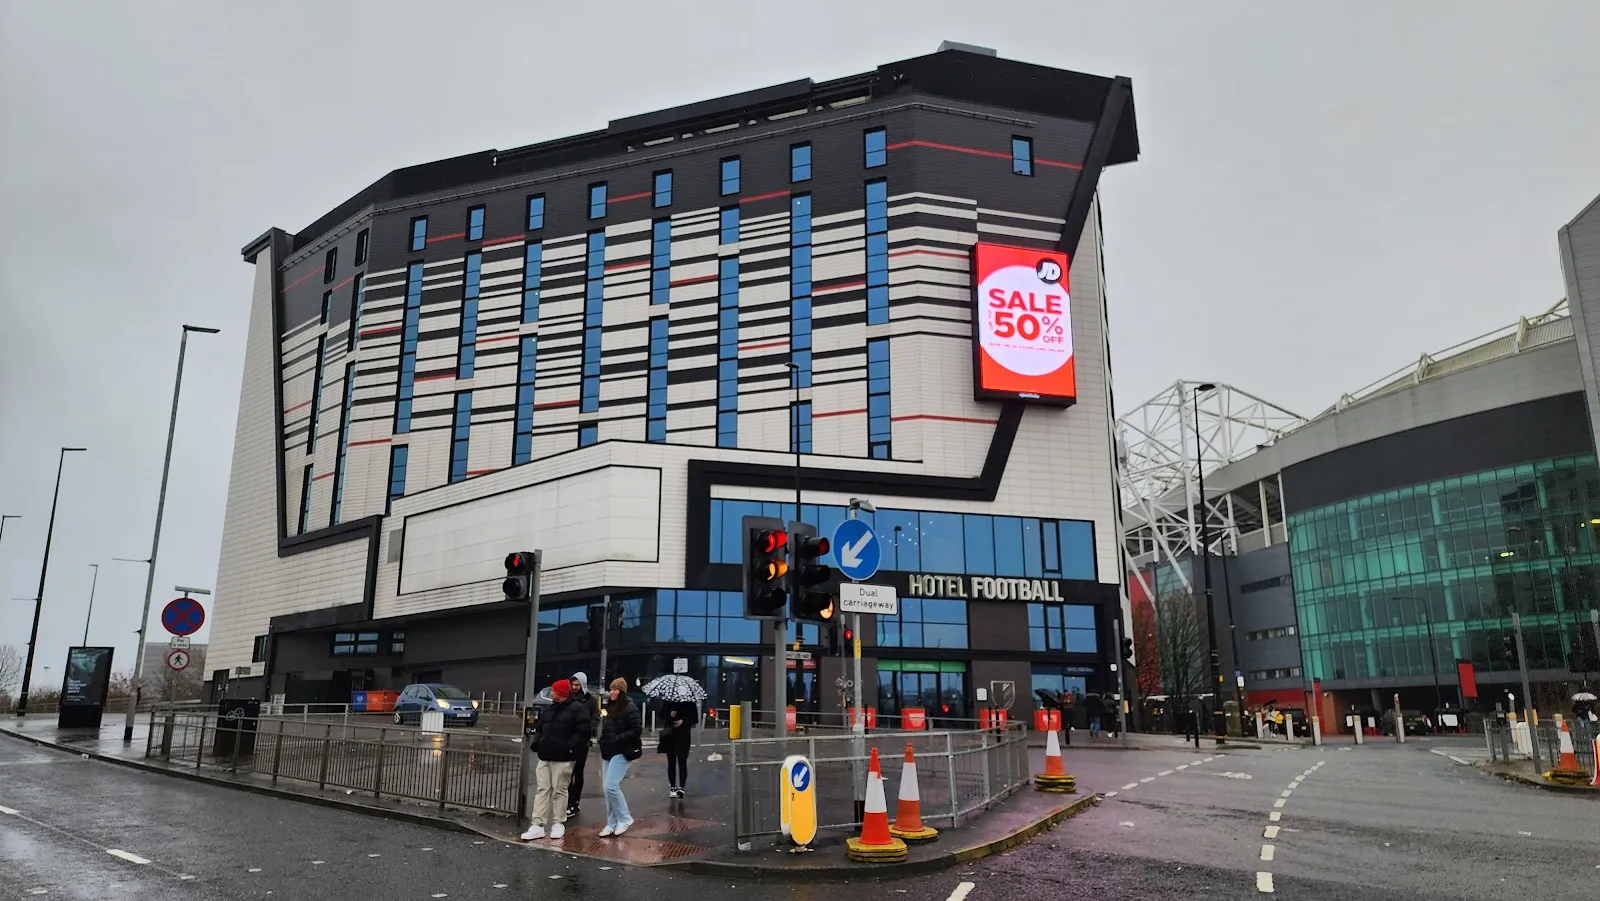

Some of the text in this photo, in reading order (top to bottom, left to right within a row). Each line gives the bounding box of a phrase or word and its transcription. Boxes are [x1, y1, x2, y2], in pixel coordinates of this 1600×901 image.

[1037, 261, 1061, 280] JD
[989, 288, 1062, 315] SALE
[1042, 335, 1064, 344] OFF
[859, 588, 878, 597] Dual
[909, 574, 1064, 602] HOTEL FOOTBALL
[843, 598, 894, 610] carriageway
